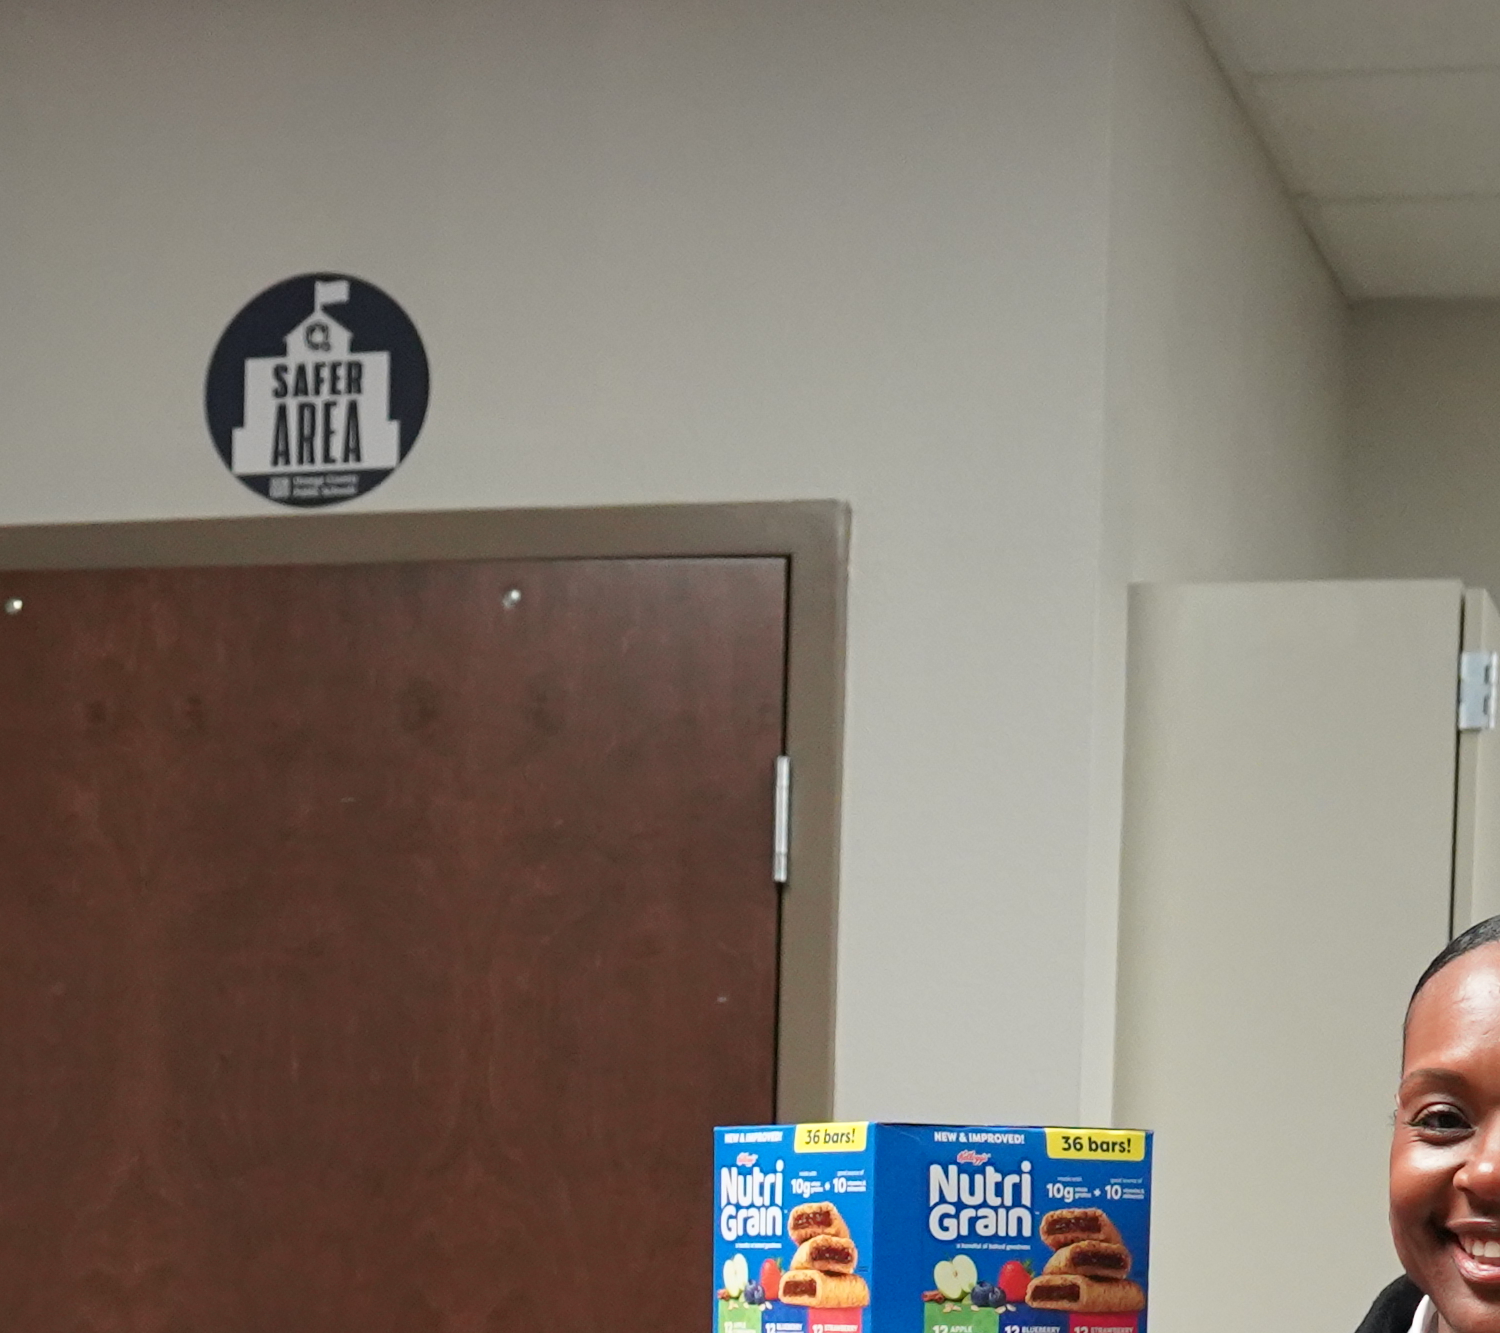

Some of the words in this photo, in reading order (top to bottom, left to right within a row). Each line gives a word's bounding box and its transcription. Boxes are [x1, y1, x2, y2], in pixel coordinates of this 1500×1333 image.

[272, 360, 363, 398] SAFER
[271, 400, 362, 467] AREA
[805, 1129, 820, 1145] 36
[823, 1128, 855, 1145] bars!
[934, 1131, 957, 1142] NEW
[969, 1132, 1025, 1144] IMPROVED!
[1061, 1136, 1083, 1152] 36
[1088, 1137, 1131, 1153] bars!
[721, 1159, 784, 1209] Nutri
[929, 1160, 1032, 1208] Nutri
[721, 1204, 783, 1241] Grain
[928, 1203, 1032, 1241] Grain
